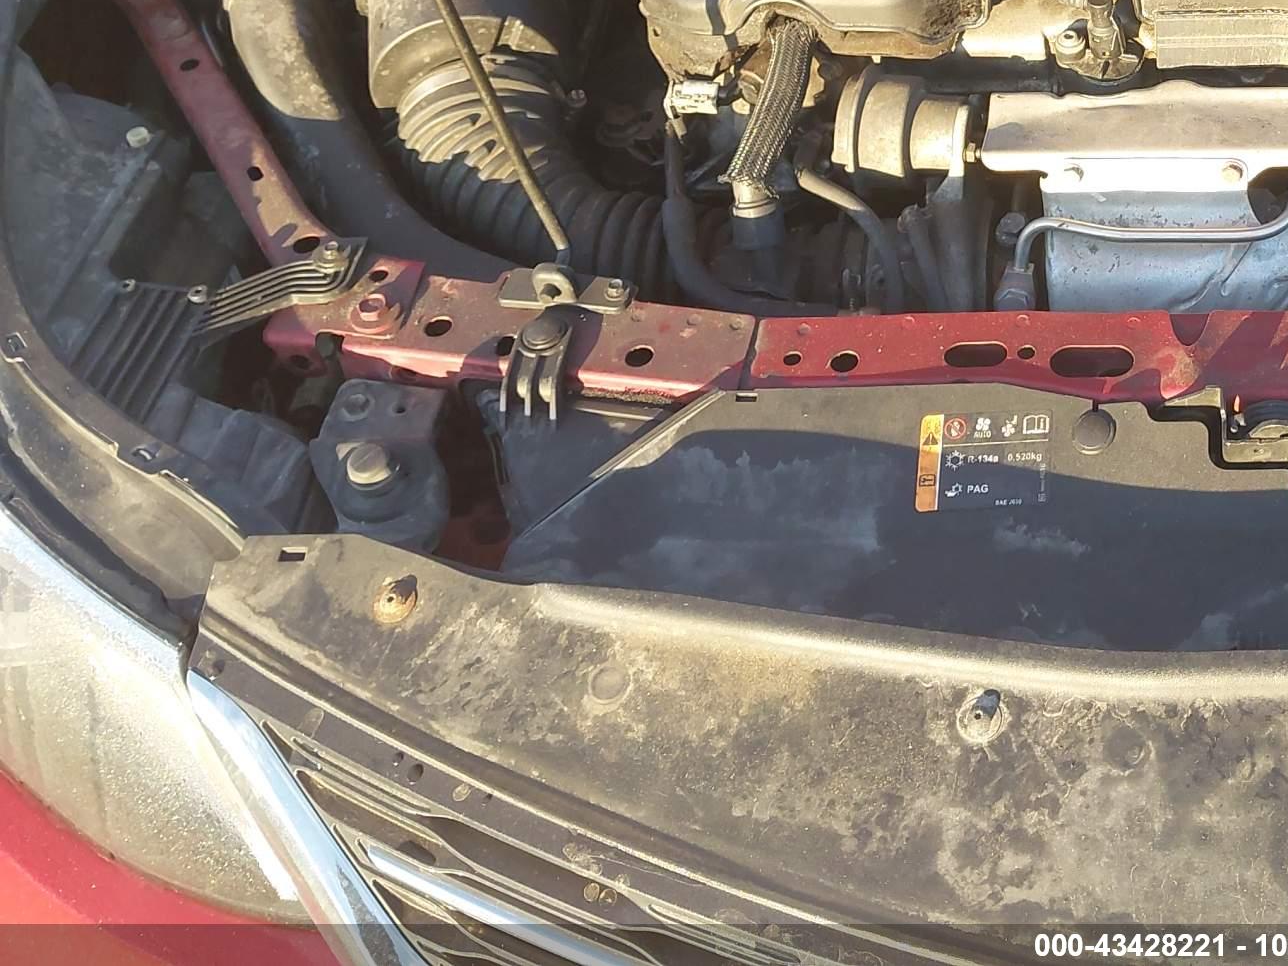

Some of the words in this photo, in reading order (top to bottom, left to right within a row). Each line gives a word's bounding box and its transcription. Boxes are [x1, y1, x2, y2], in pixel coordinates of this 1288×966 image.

[968, 455, 999, 463] R-134a
[1007, 451, 1043, 462] 0.520kg
[967, 485, 989, 493] PAG
